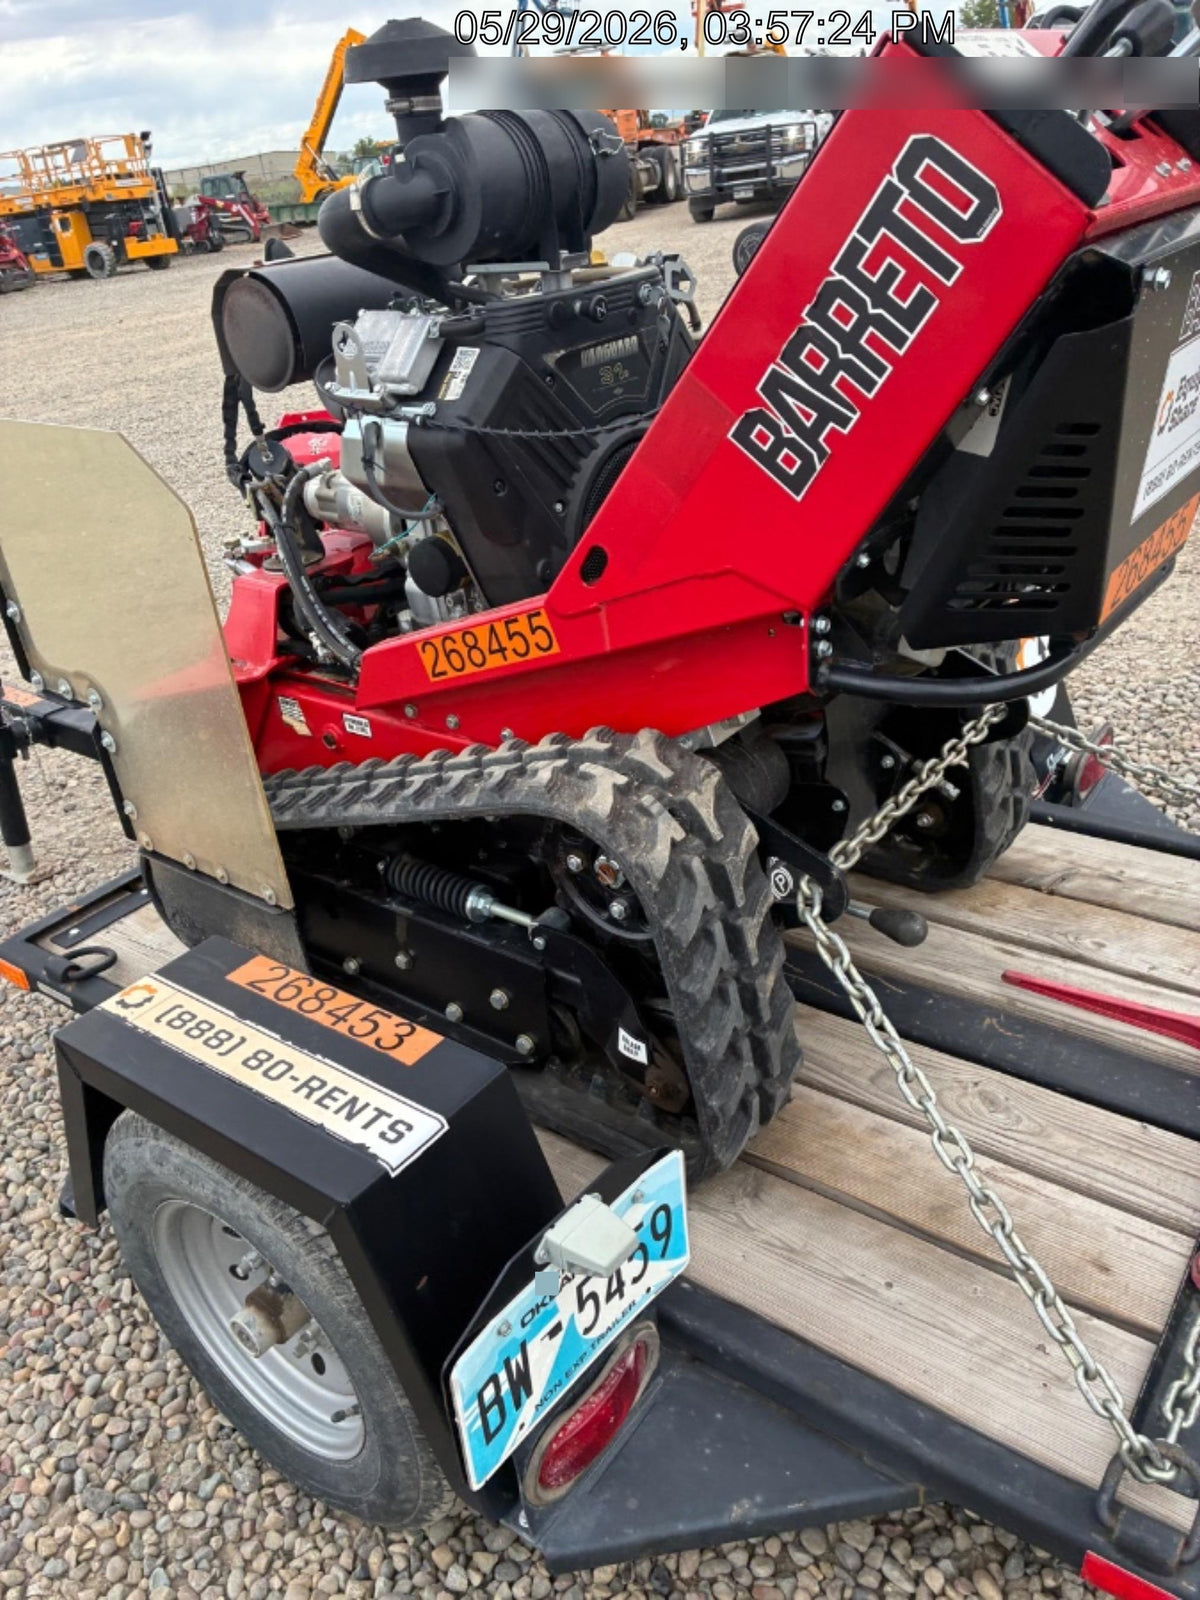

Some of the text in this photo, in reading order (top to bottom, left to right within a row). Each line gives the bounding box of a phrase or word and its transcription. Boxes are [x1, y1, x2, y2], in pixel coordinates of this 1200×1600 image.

[580, 334, 639, 369] VANGUARD
[727, 133, 1003, 502] BARRETO
[420, 610, 554, 678] 268455
[245, 964, 417, 1051] 268453
[153, 1003, 414, 1145] (888) 80-RENTS
[477, 1338, 533, 1446] BW
[535, 1378, 563, 1412] NON
[590, 1299, 636, 1351] TRAILER
